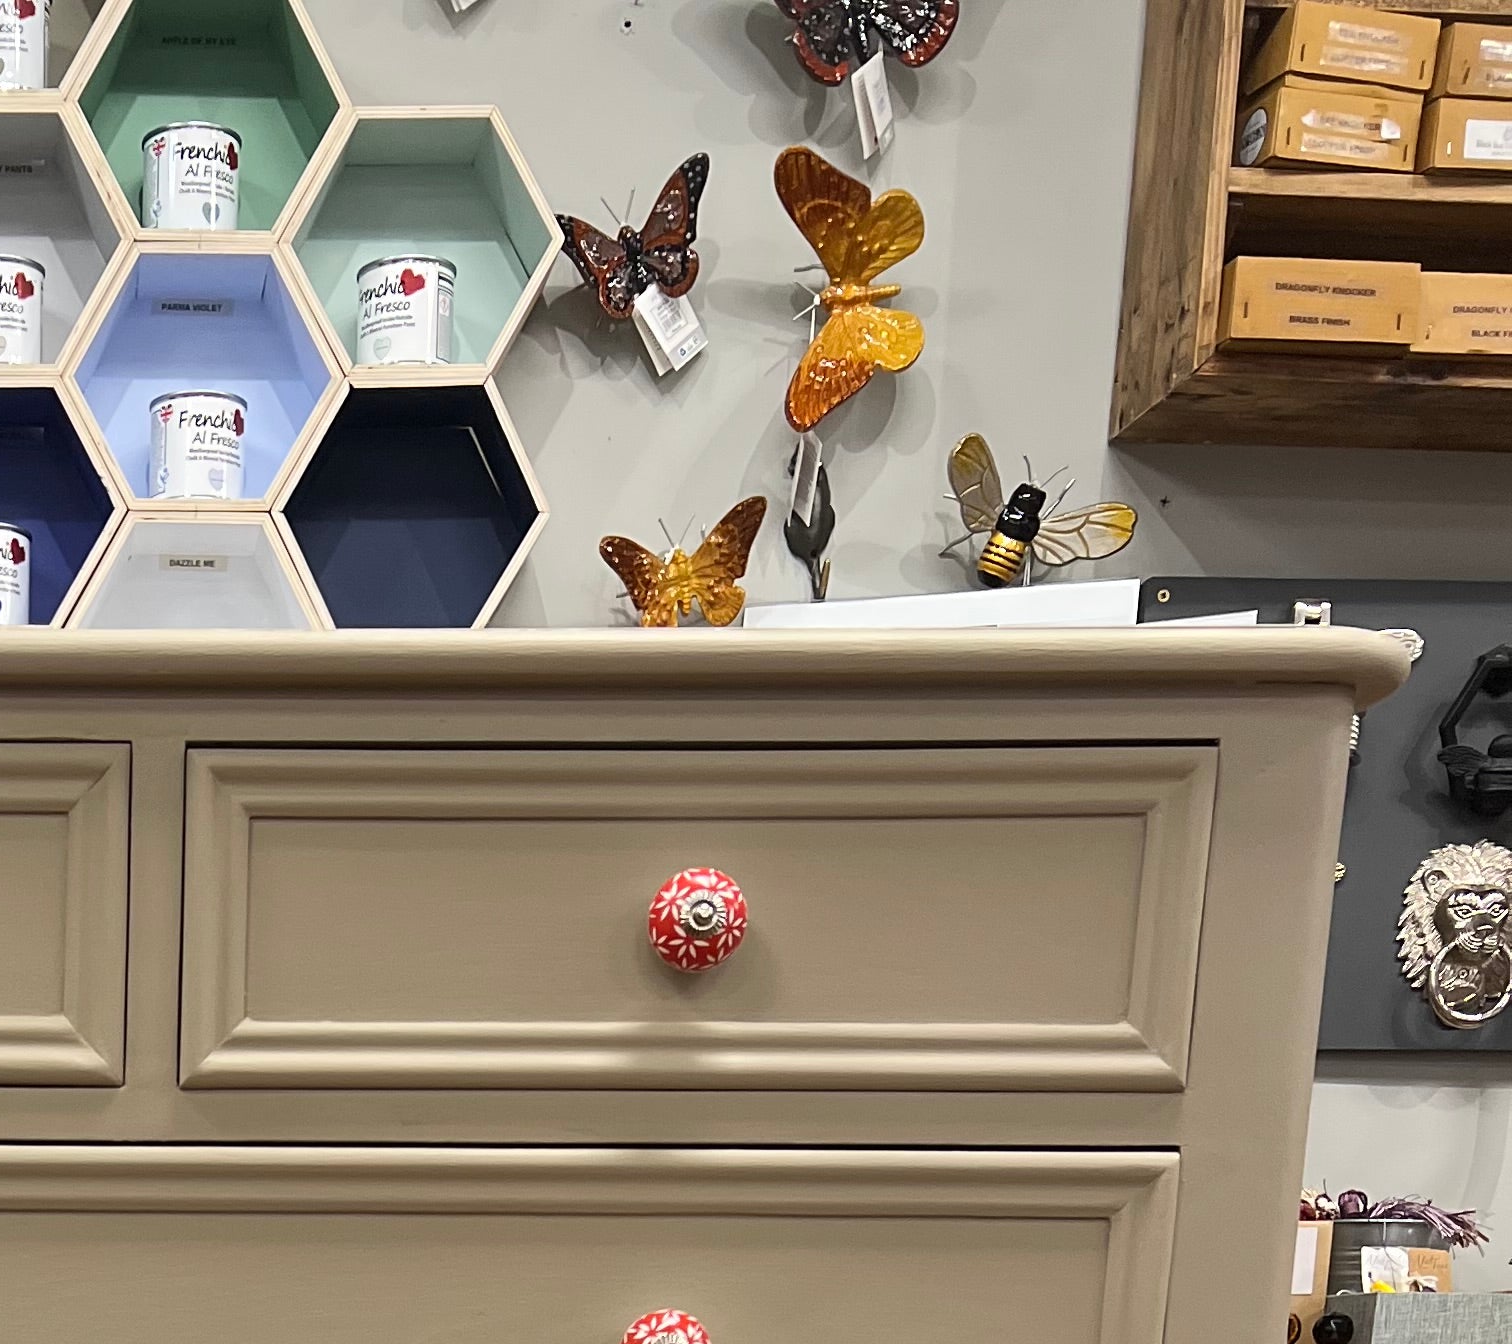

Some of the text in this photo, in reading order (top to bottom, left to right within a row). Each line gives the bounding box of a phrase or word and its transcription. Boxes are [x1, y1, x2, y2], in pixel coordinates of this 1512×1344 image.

[185, 163, 200, 176] Al
[1275, 282, 1330, 294] DRAGONFLY
[374, 301, 411, 316] Fresco
[1289, 315, 1319, 325] BRASS
[179, 410, 238, 432] Frenchic
[192, 430, 240, 450] Al Fresco
[169, 559, 216, 568] DAZZLE ME
